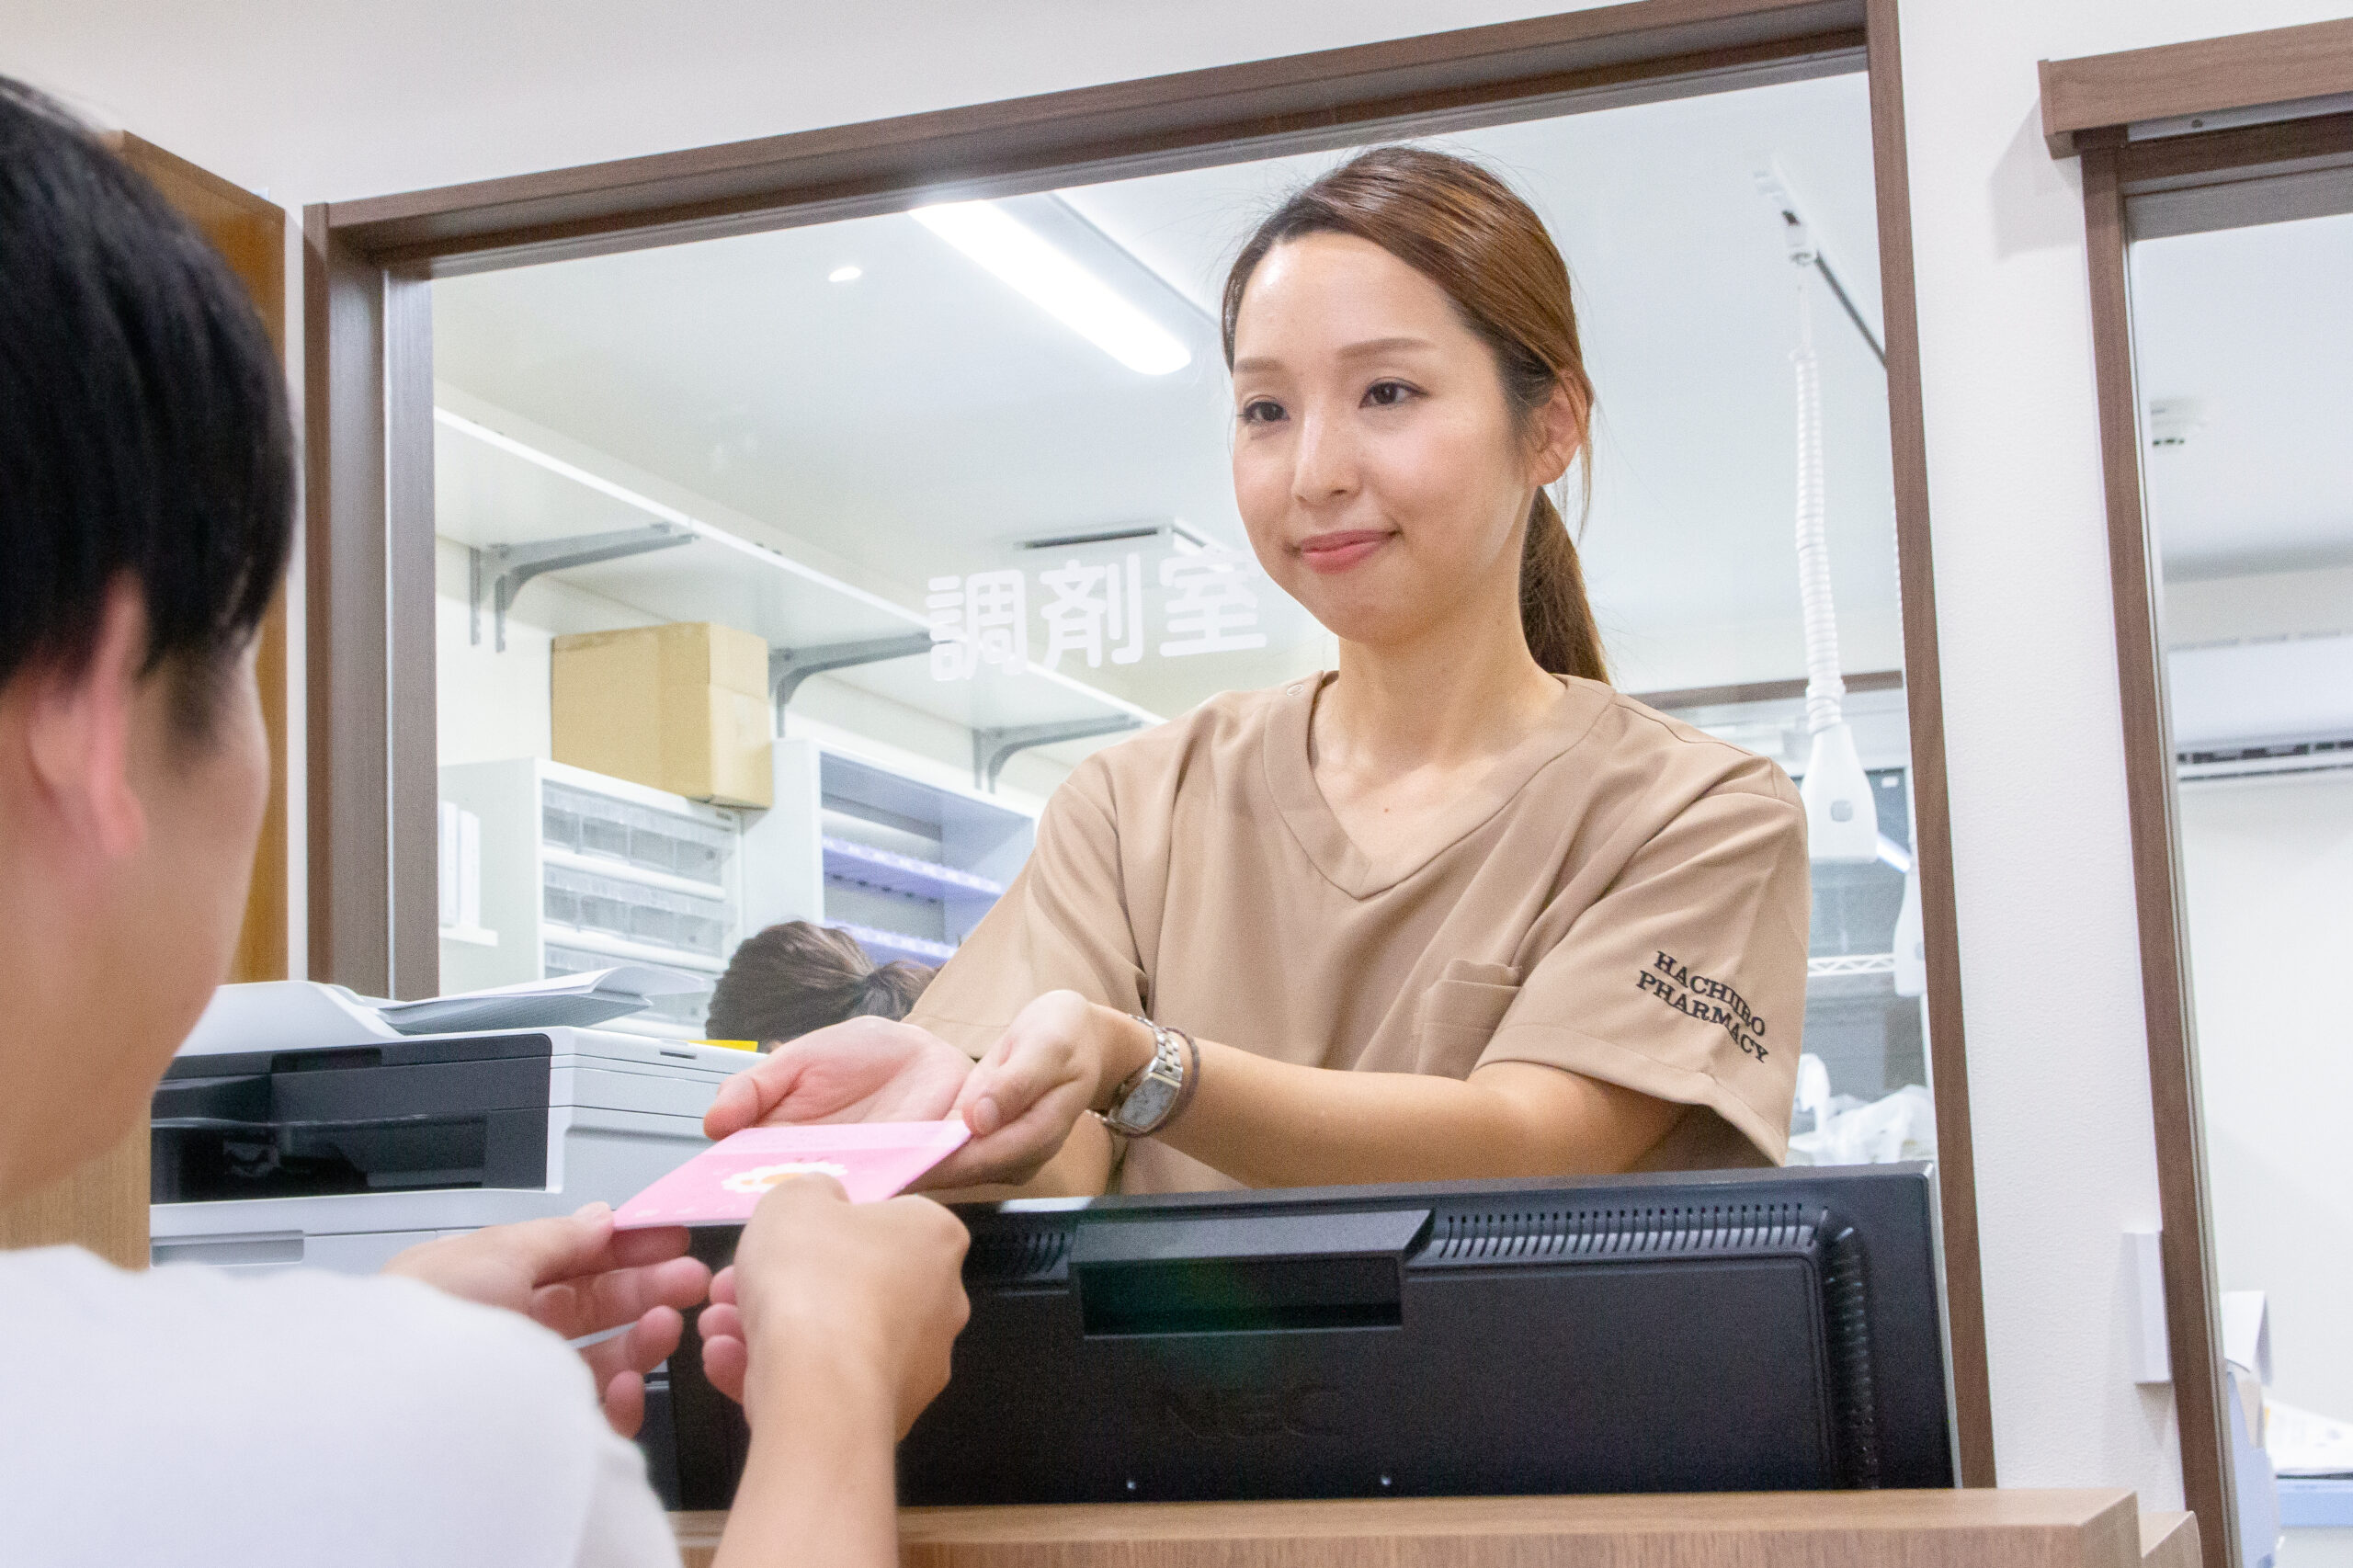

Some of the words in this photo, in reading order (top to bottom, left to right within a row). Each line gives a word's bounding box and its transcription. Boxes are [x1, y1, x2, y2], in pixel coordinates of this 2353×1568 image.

[926, 553, 1267, 682] 調剤室
[1636, 970, 1769, 1063] PHARMACY
[1654, 950, 1766, 1037] HACHIRO
[1152, 1384, 1340, 1441] NEC
